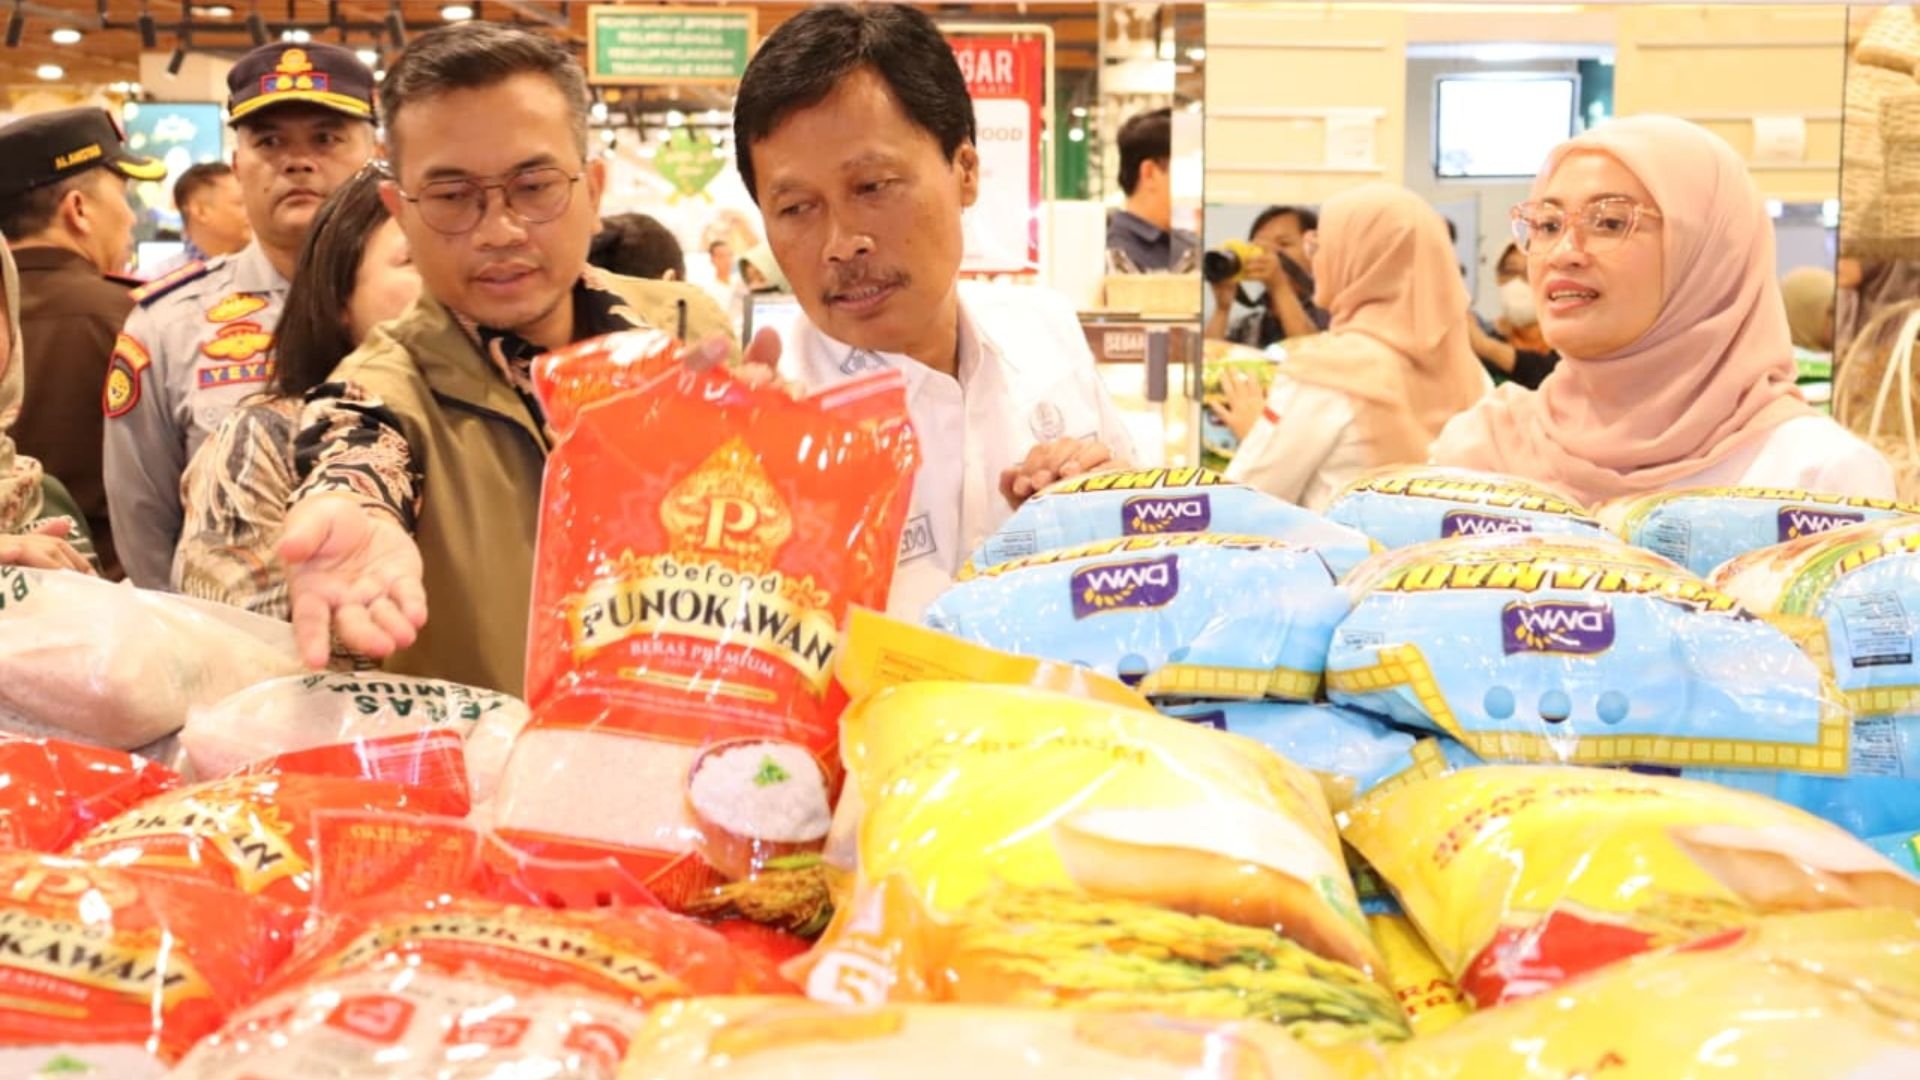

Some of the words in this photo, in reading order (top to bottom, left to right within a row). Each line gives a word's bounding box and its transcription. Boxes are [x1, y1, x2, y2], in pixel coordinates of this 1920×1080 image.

[974, 126, 1024, 142] OOD
[700, 496, 758, 549] P
[1134, 501, 1202, 520] DMM
[661, 559, 777, 594] befood
[1087, 564, 1170, 590] DMM
[581, 588, 834, 671] PUNOKAWAN
[1517, 607, 1603, 632] DMM
[630, 640, 687, 657] BERAS
[691, 645, 776, 678] PREMIUM
[352, 694, 503, 723] ERAS
